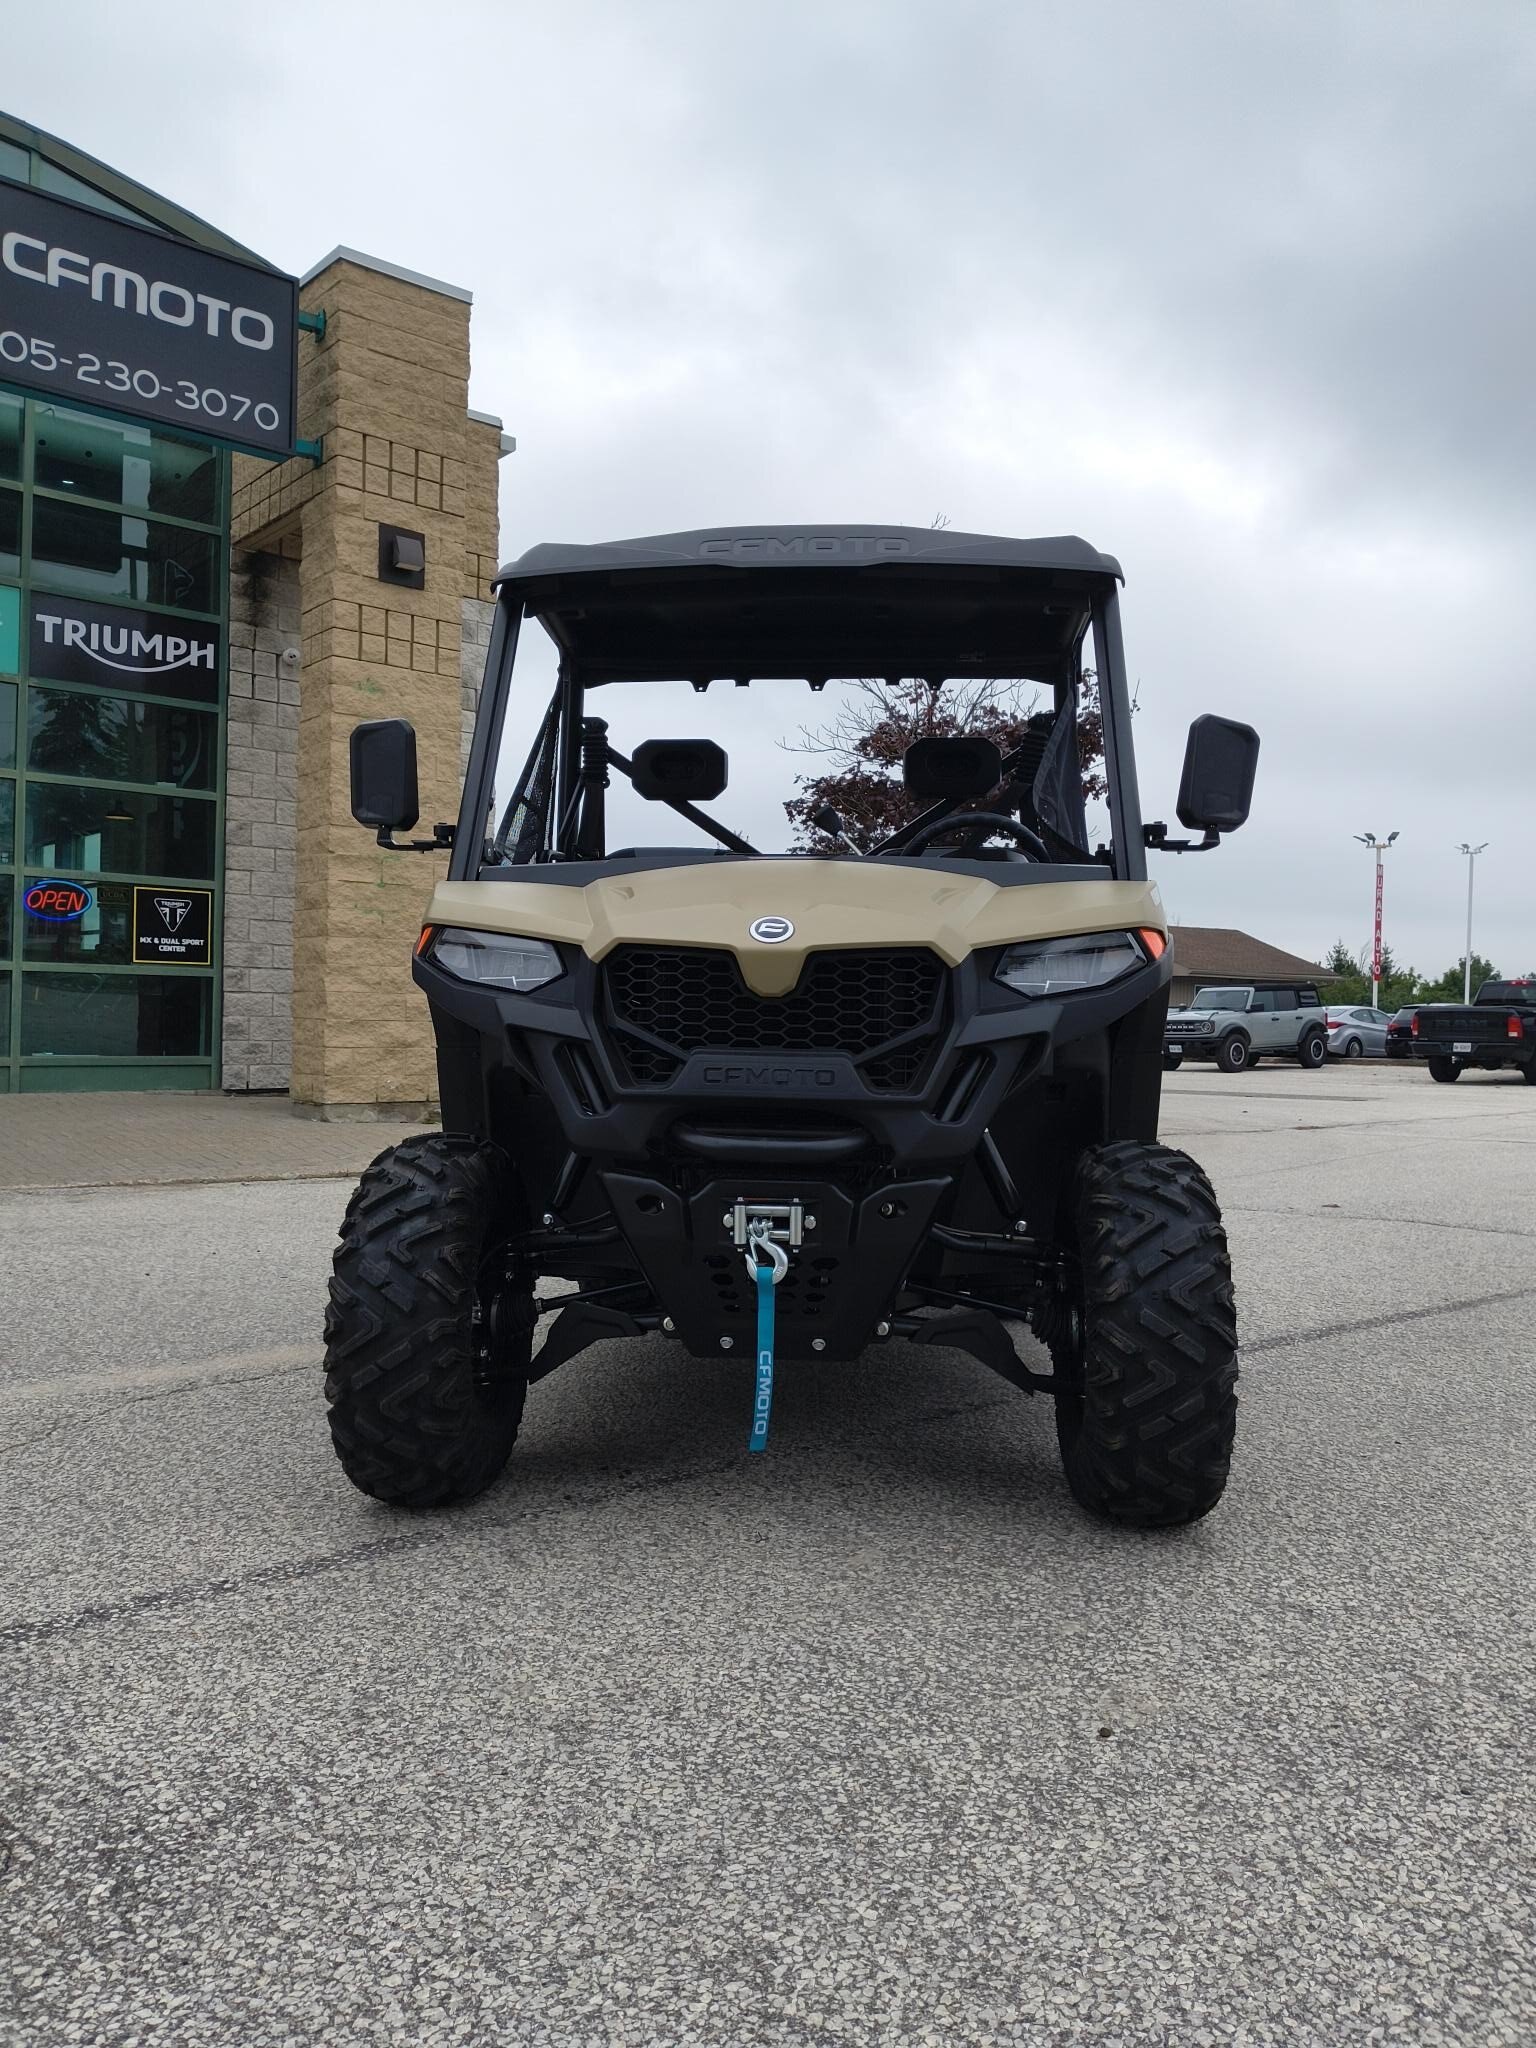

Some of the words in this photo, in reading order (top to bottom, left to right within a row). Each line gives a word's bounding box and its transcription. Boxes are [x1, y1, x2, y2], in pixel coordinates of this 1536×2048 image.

[2, 231, 274, 351] CFMOTO
[0, 331, 280, 431] 05-230-3070
[700, 536, 910, 555] CFMOTO
[35, 613, 215, 673] TRIUMPH
[26, 889, 85, 911] OPEN
[1375, 865, 1383, 921] MURAD
[139, 936, 152, 944] MX
[160, 937, 180, 945] DUAL
[181, 938, 205, 946] SPORT
[703, 1067, 836, 1087] CFMOTO
[754, 1350, 773, 1436] CFMOTO
